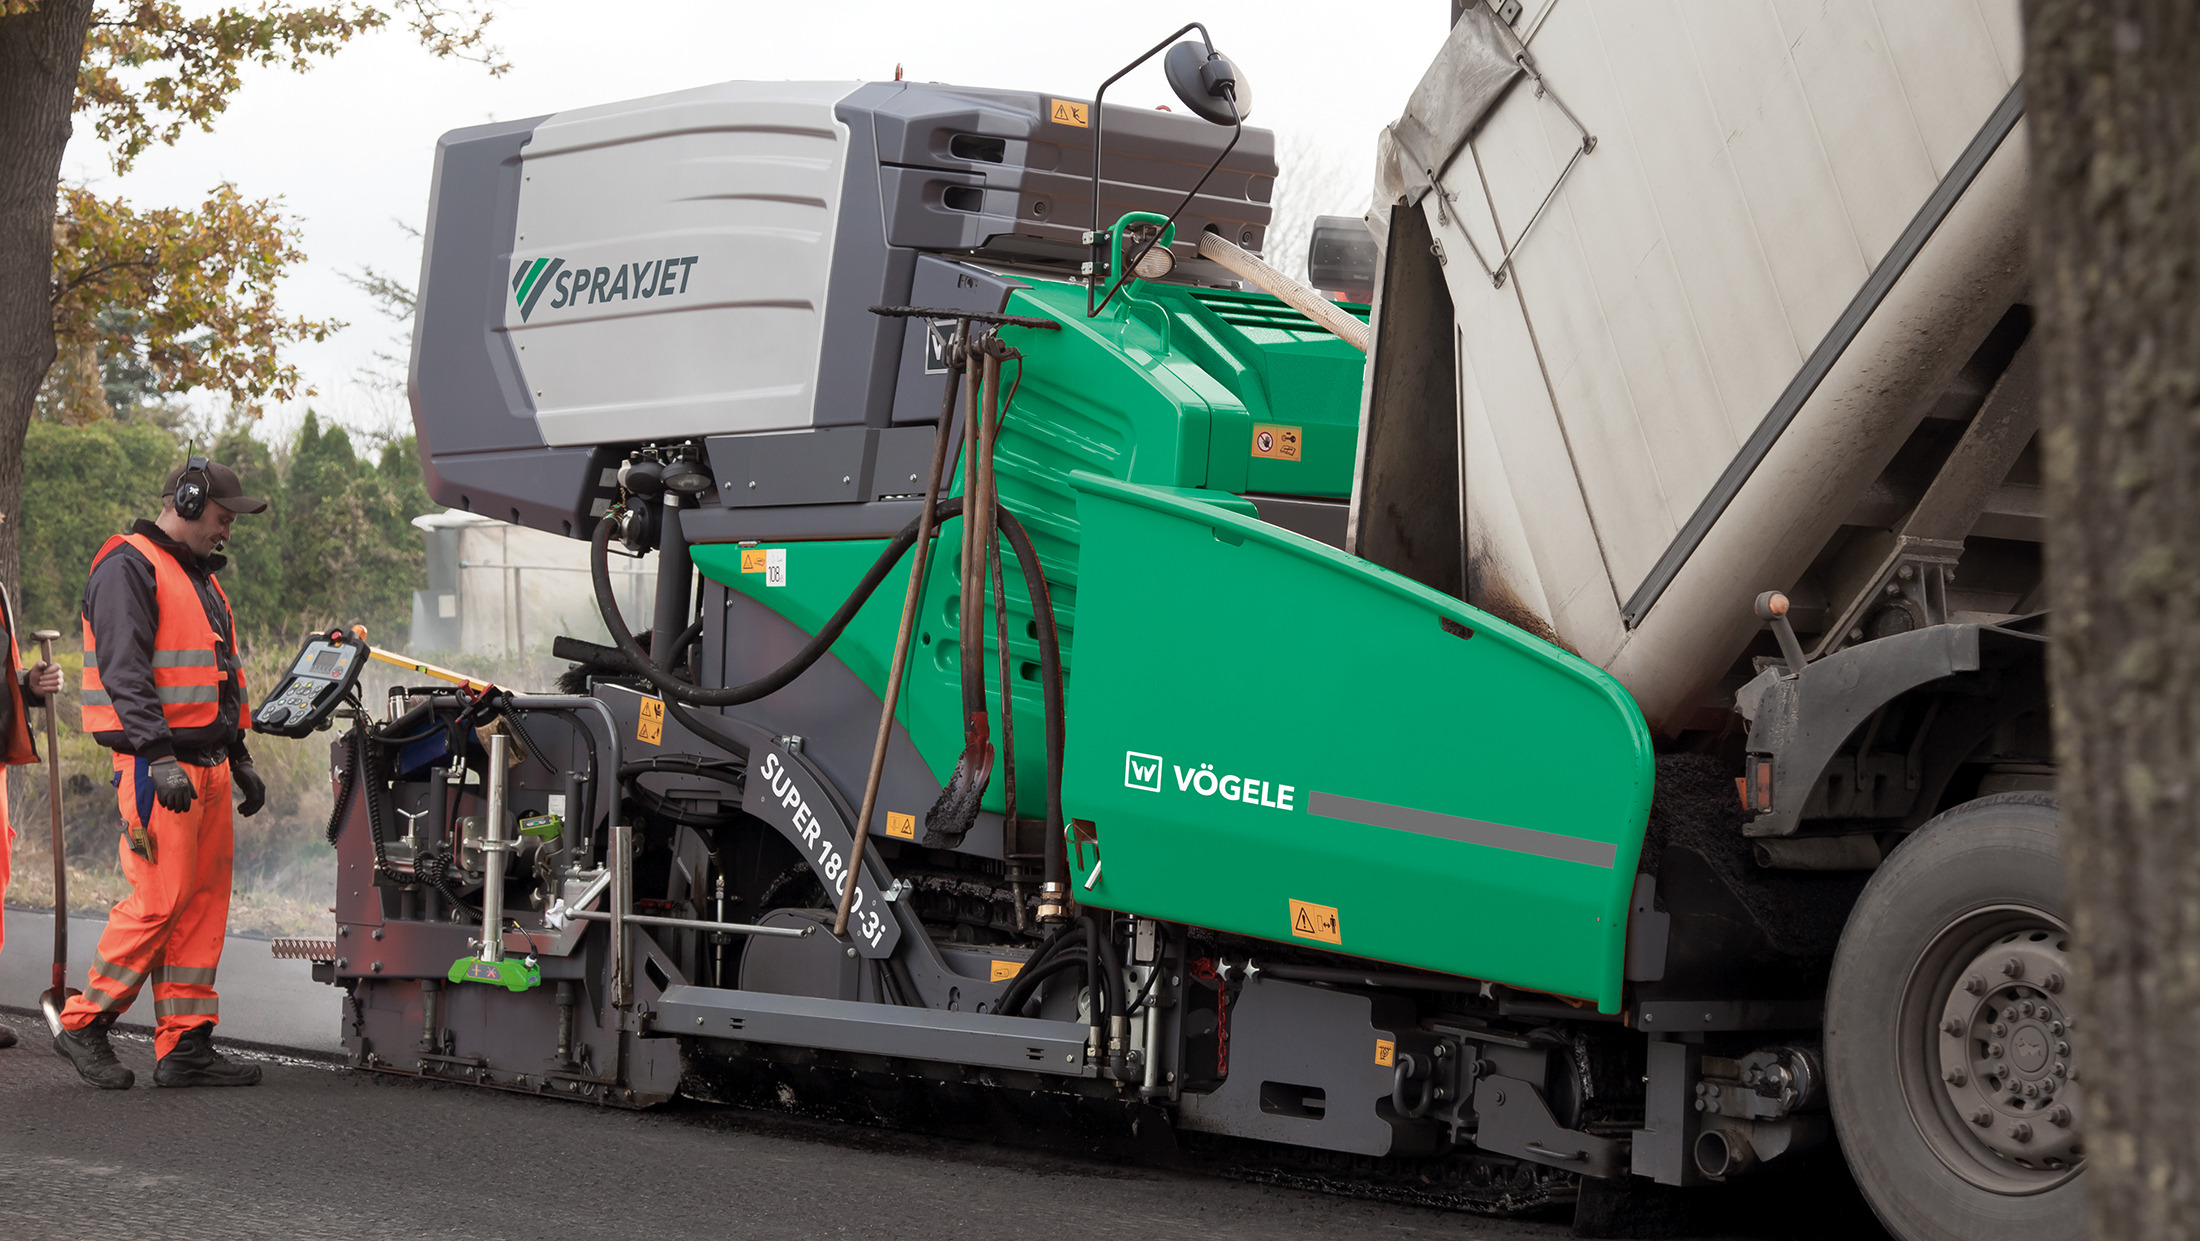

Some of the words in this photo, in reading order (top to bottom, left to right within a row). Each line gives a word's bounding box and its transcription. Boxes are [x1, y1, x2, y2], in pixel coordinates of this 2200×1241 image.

[550, 255, 699, 309] SPRAYJET
[768, 565, 780, 583] 108
[760, 752, 821, 850] SUPER
[1173, 762, 1295, 811] VÖGELE
